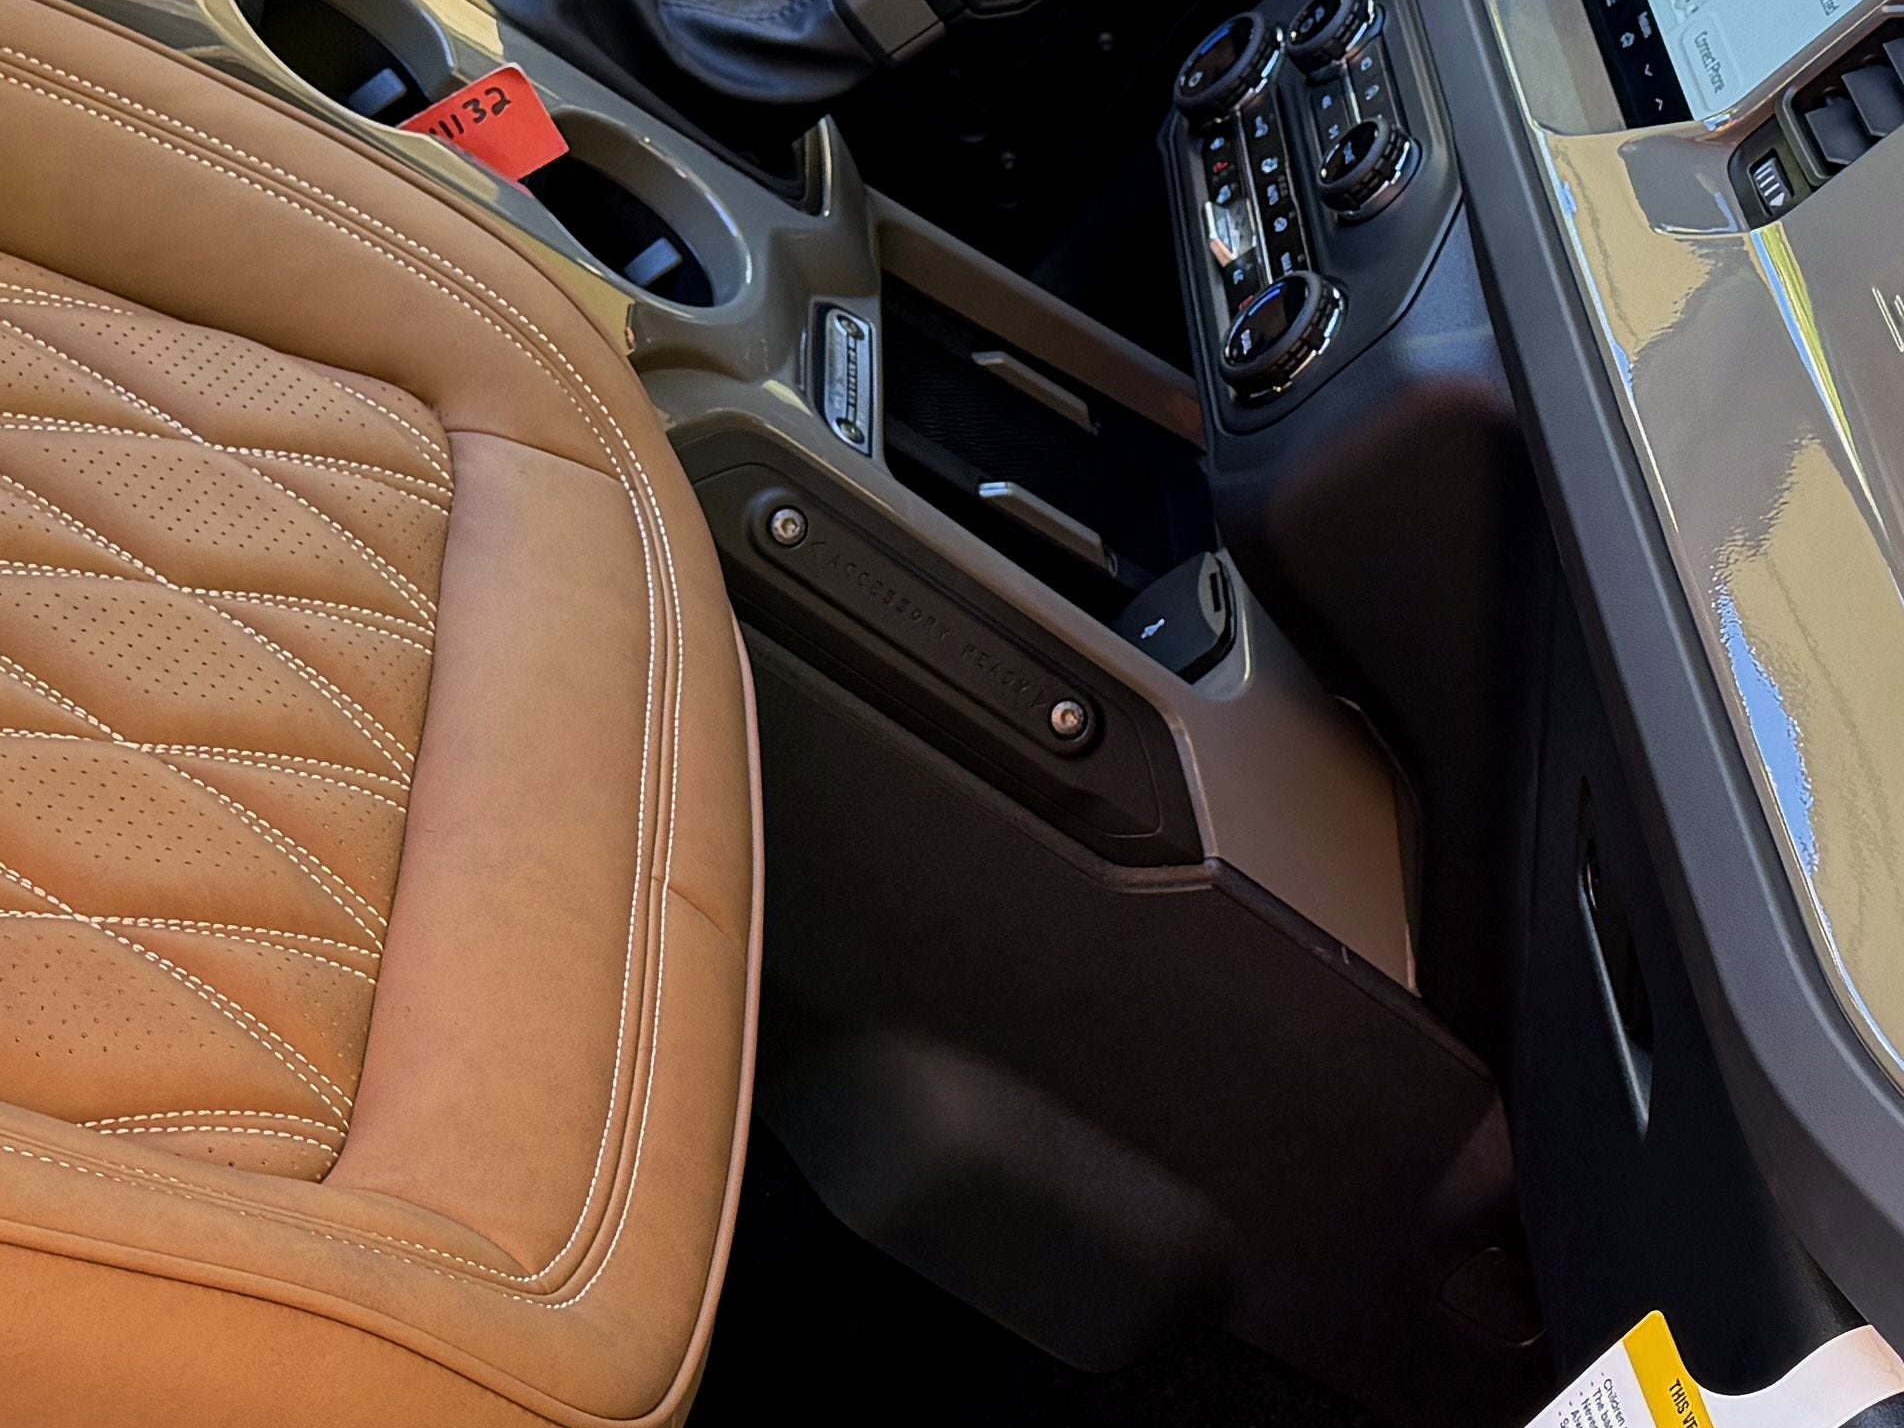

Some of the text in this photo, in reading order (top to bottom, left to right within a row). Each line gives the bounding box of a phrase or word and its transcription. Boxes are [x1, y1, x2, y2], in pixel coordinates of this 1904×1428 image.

[1693, 30, 1726, 94] Connect Phone
[1591, 1386, 1605, 1412] The
[1602, 1377, 1626, 1427] Children
[1668, 1377, 1690, 1415] THIS
